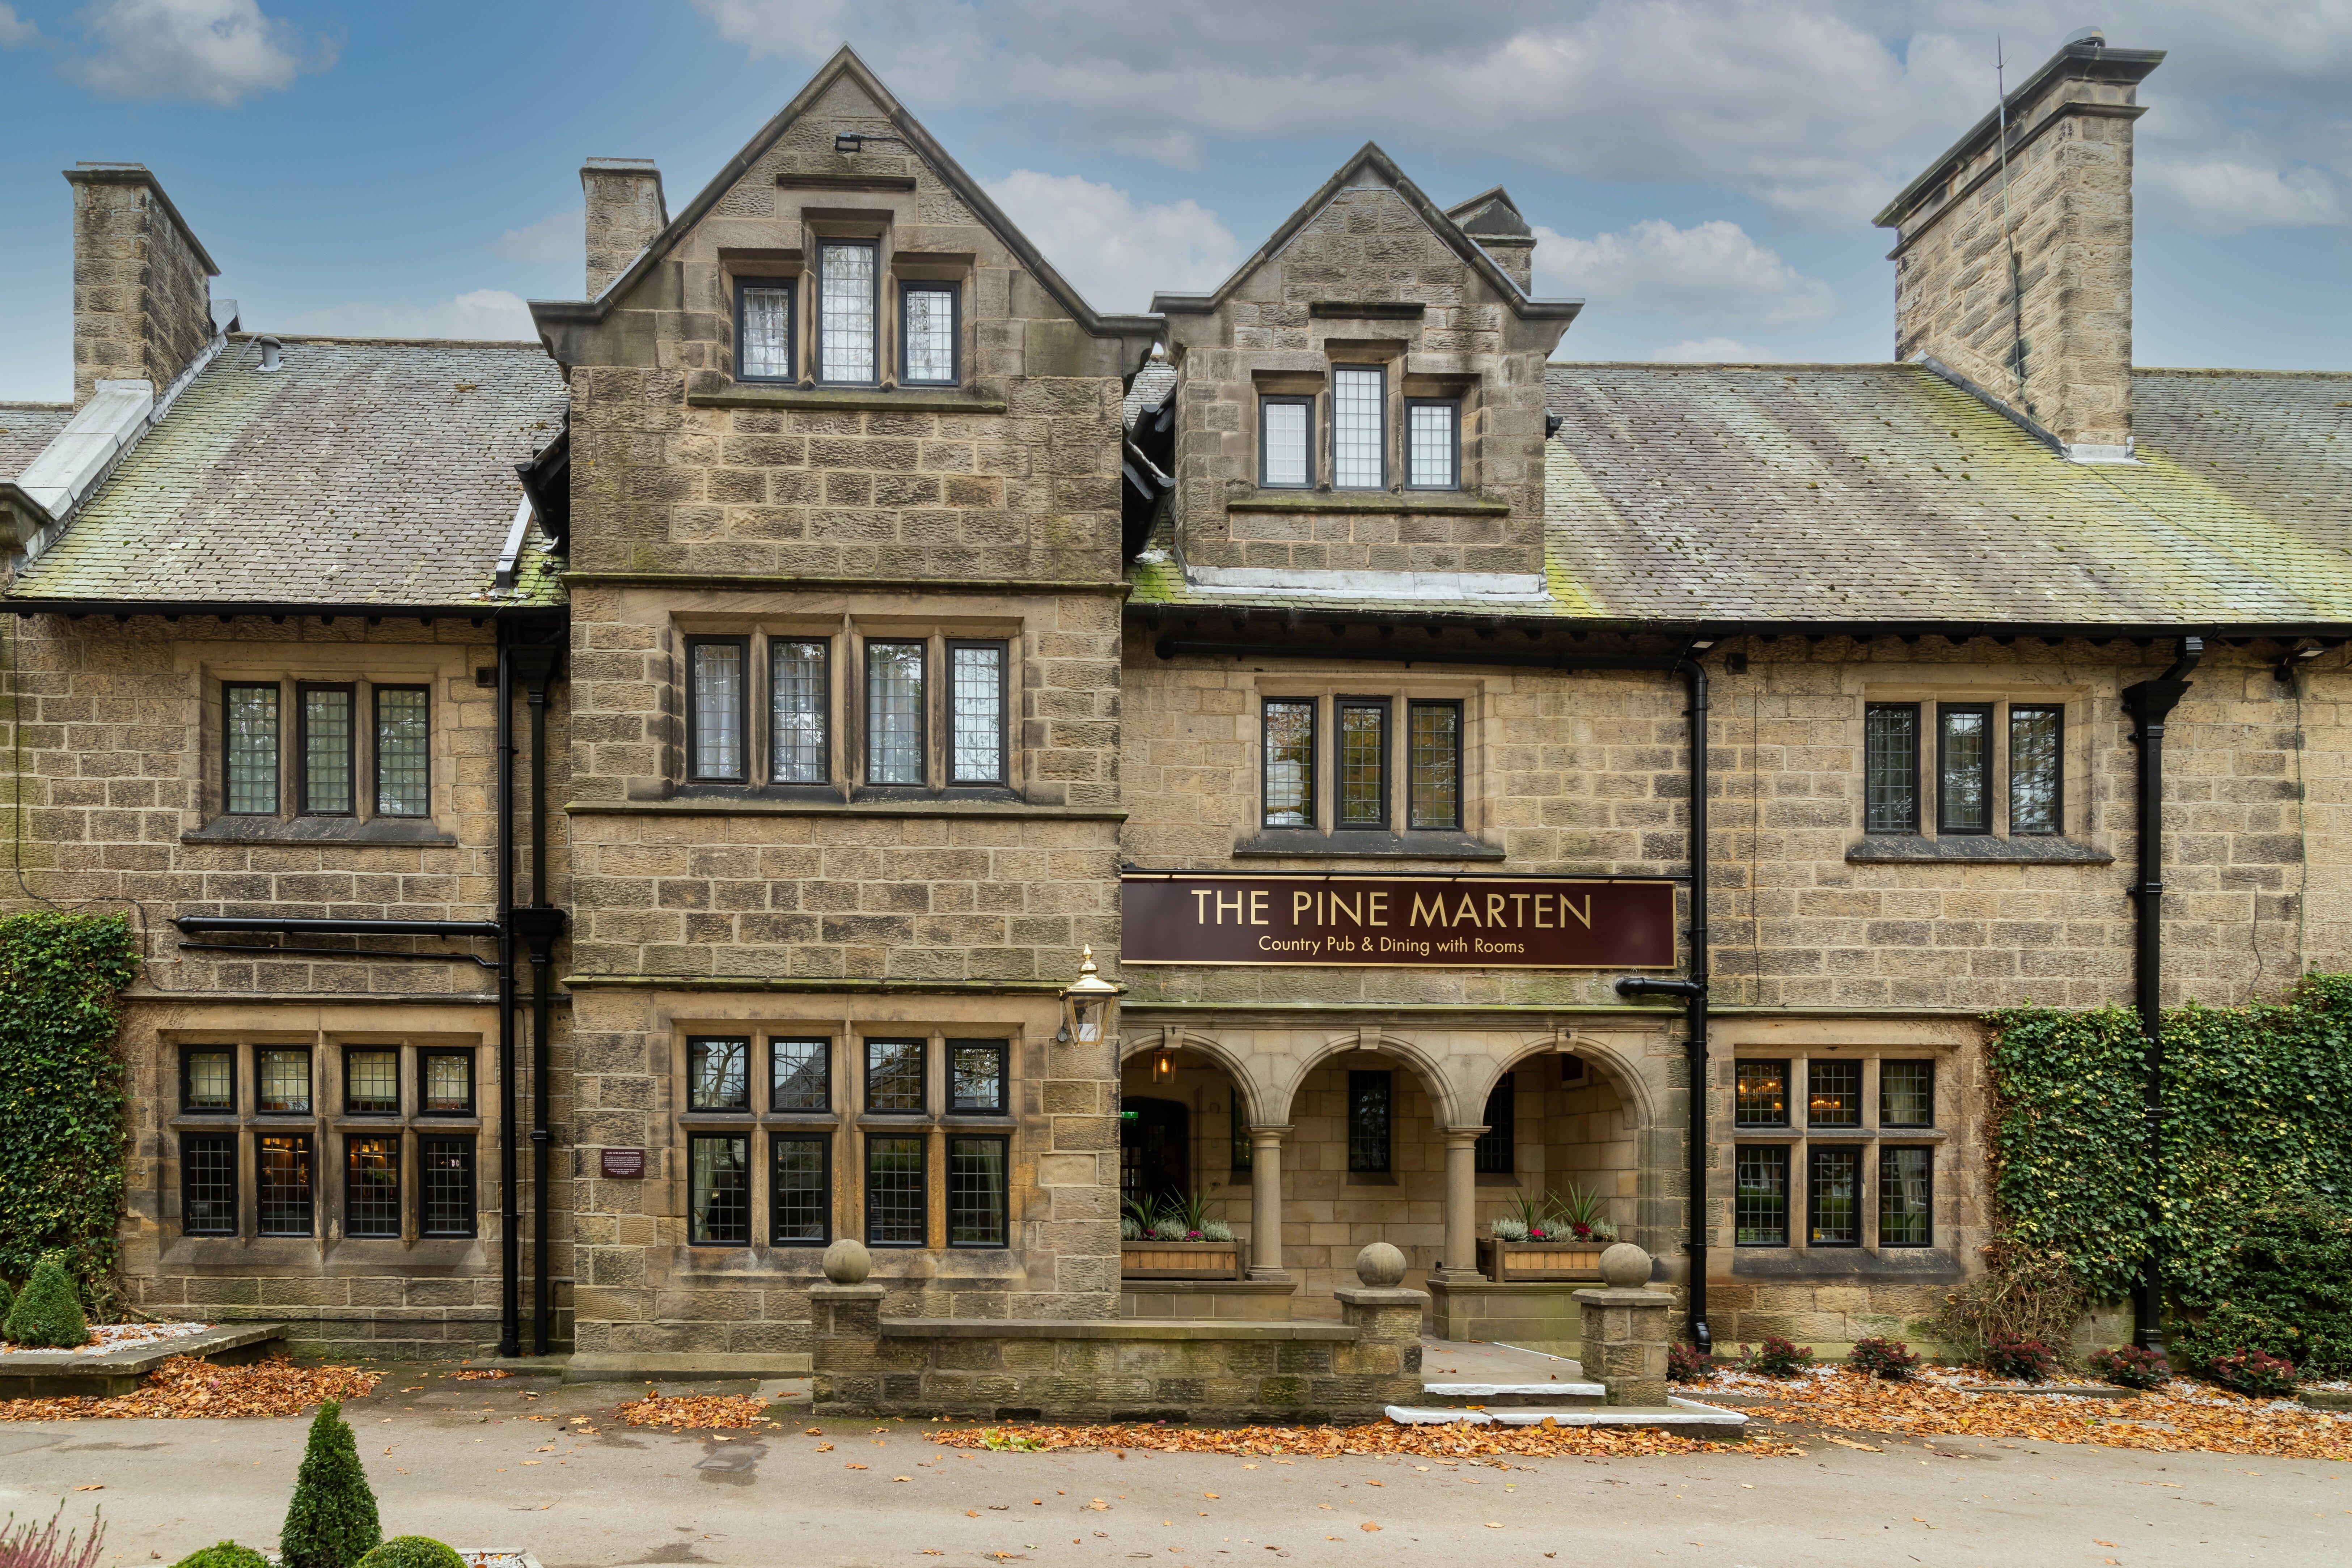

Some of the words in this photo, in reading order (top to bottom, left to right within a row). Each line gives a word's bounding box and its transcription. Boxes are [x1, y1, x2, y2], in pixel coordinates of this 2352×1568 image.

[1190, 890, 1269, 925] THE
[1293, 891, 1387, 927] PINE
[1410, 892, 1591, 929] MARTEN
[1259, 936, 1321, 955] Country
[1328, 936, 1354, 951] Pub
[1362, 936, 1374, 951] &
[1380, 937, 1429, 956] Dining
[1436, 937, 1467, 952] with
[1475, 938, 1524, 953] Rooms
